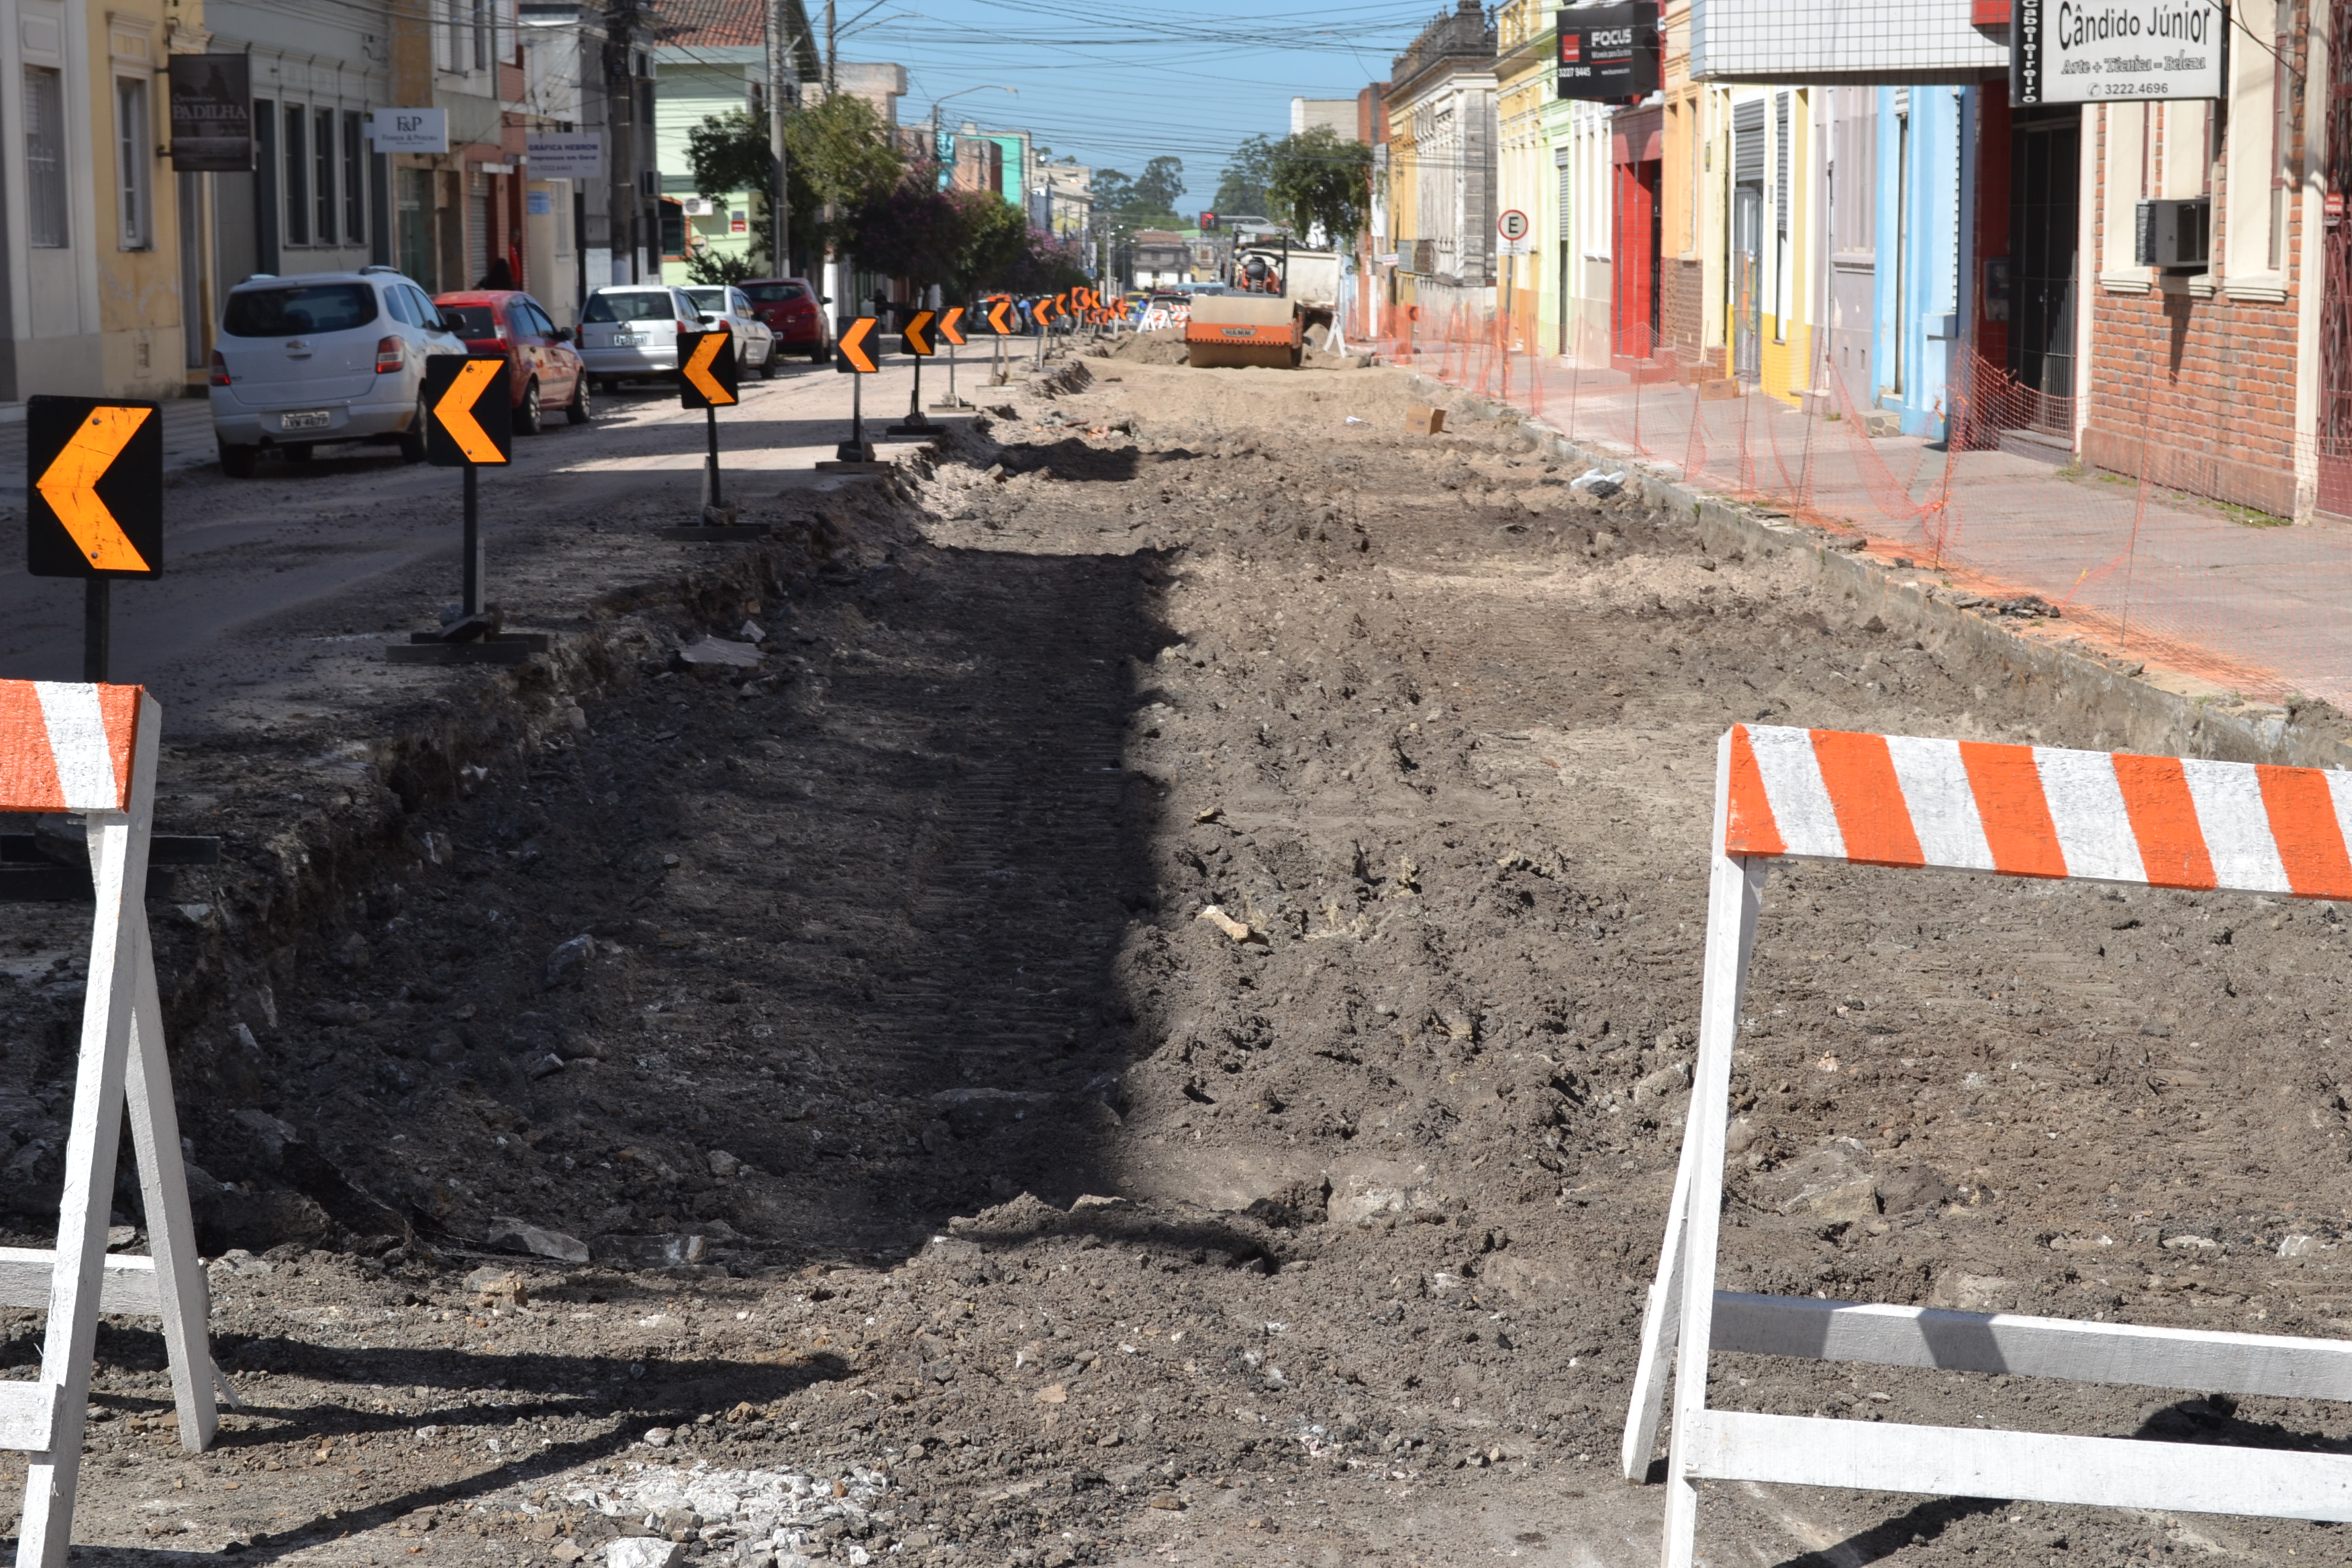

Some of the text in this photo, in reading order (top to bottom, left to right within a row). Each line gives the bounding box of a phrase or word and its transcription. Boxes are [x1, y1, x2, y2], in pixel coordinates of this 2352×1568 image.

[2059, 1, 2211, 50] Cândido Júnior
[1591, 29, 1632, 46] FOCUS
[2061, 59, 2091, 74] Arte
[2163, 50, 2206, 71] Beleza
[2104, 83, 2168, 95] 3222.4696
[173, 104, 248, 119] PADILHA
[397, 116, 422, 131] F&P
[1508, 216, 1519, 233] E
